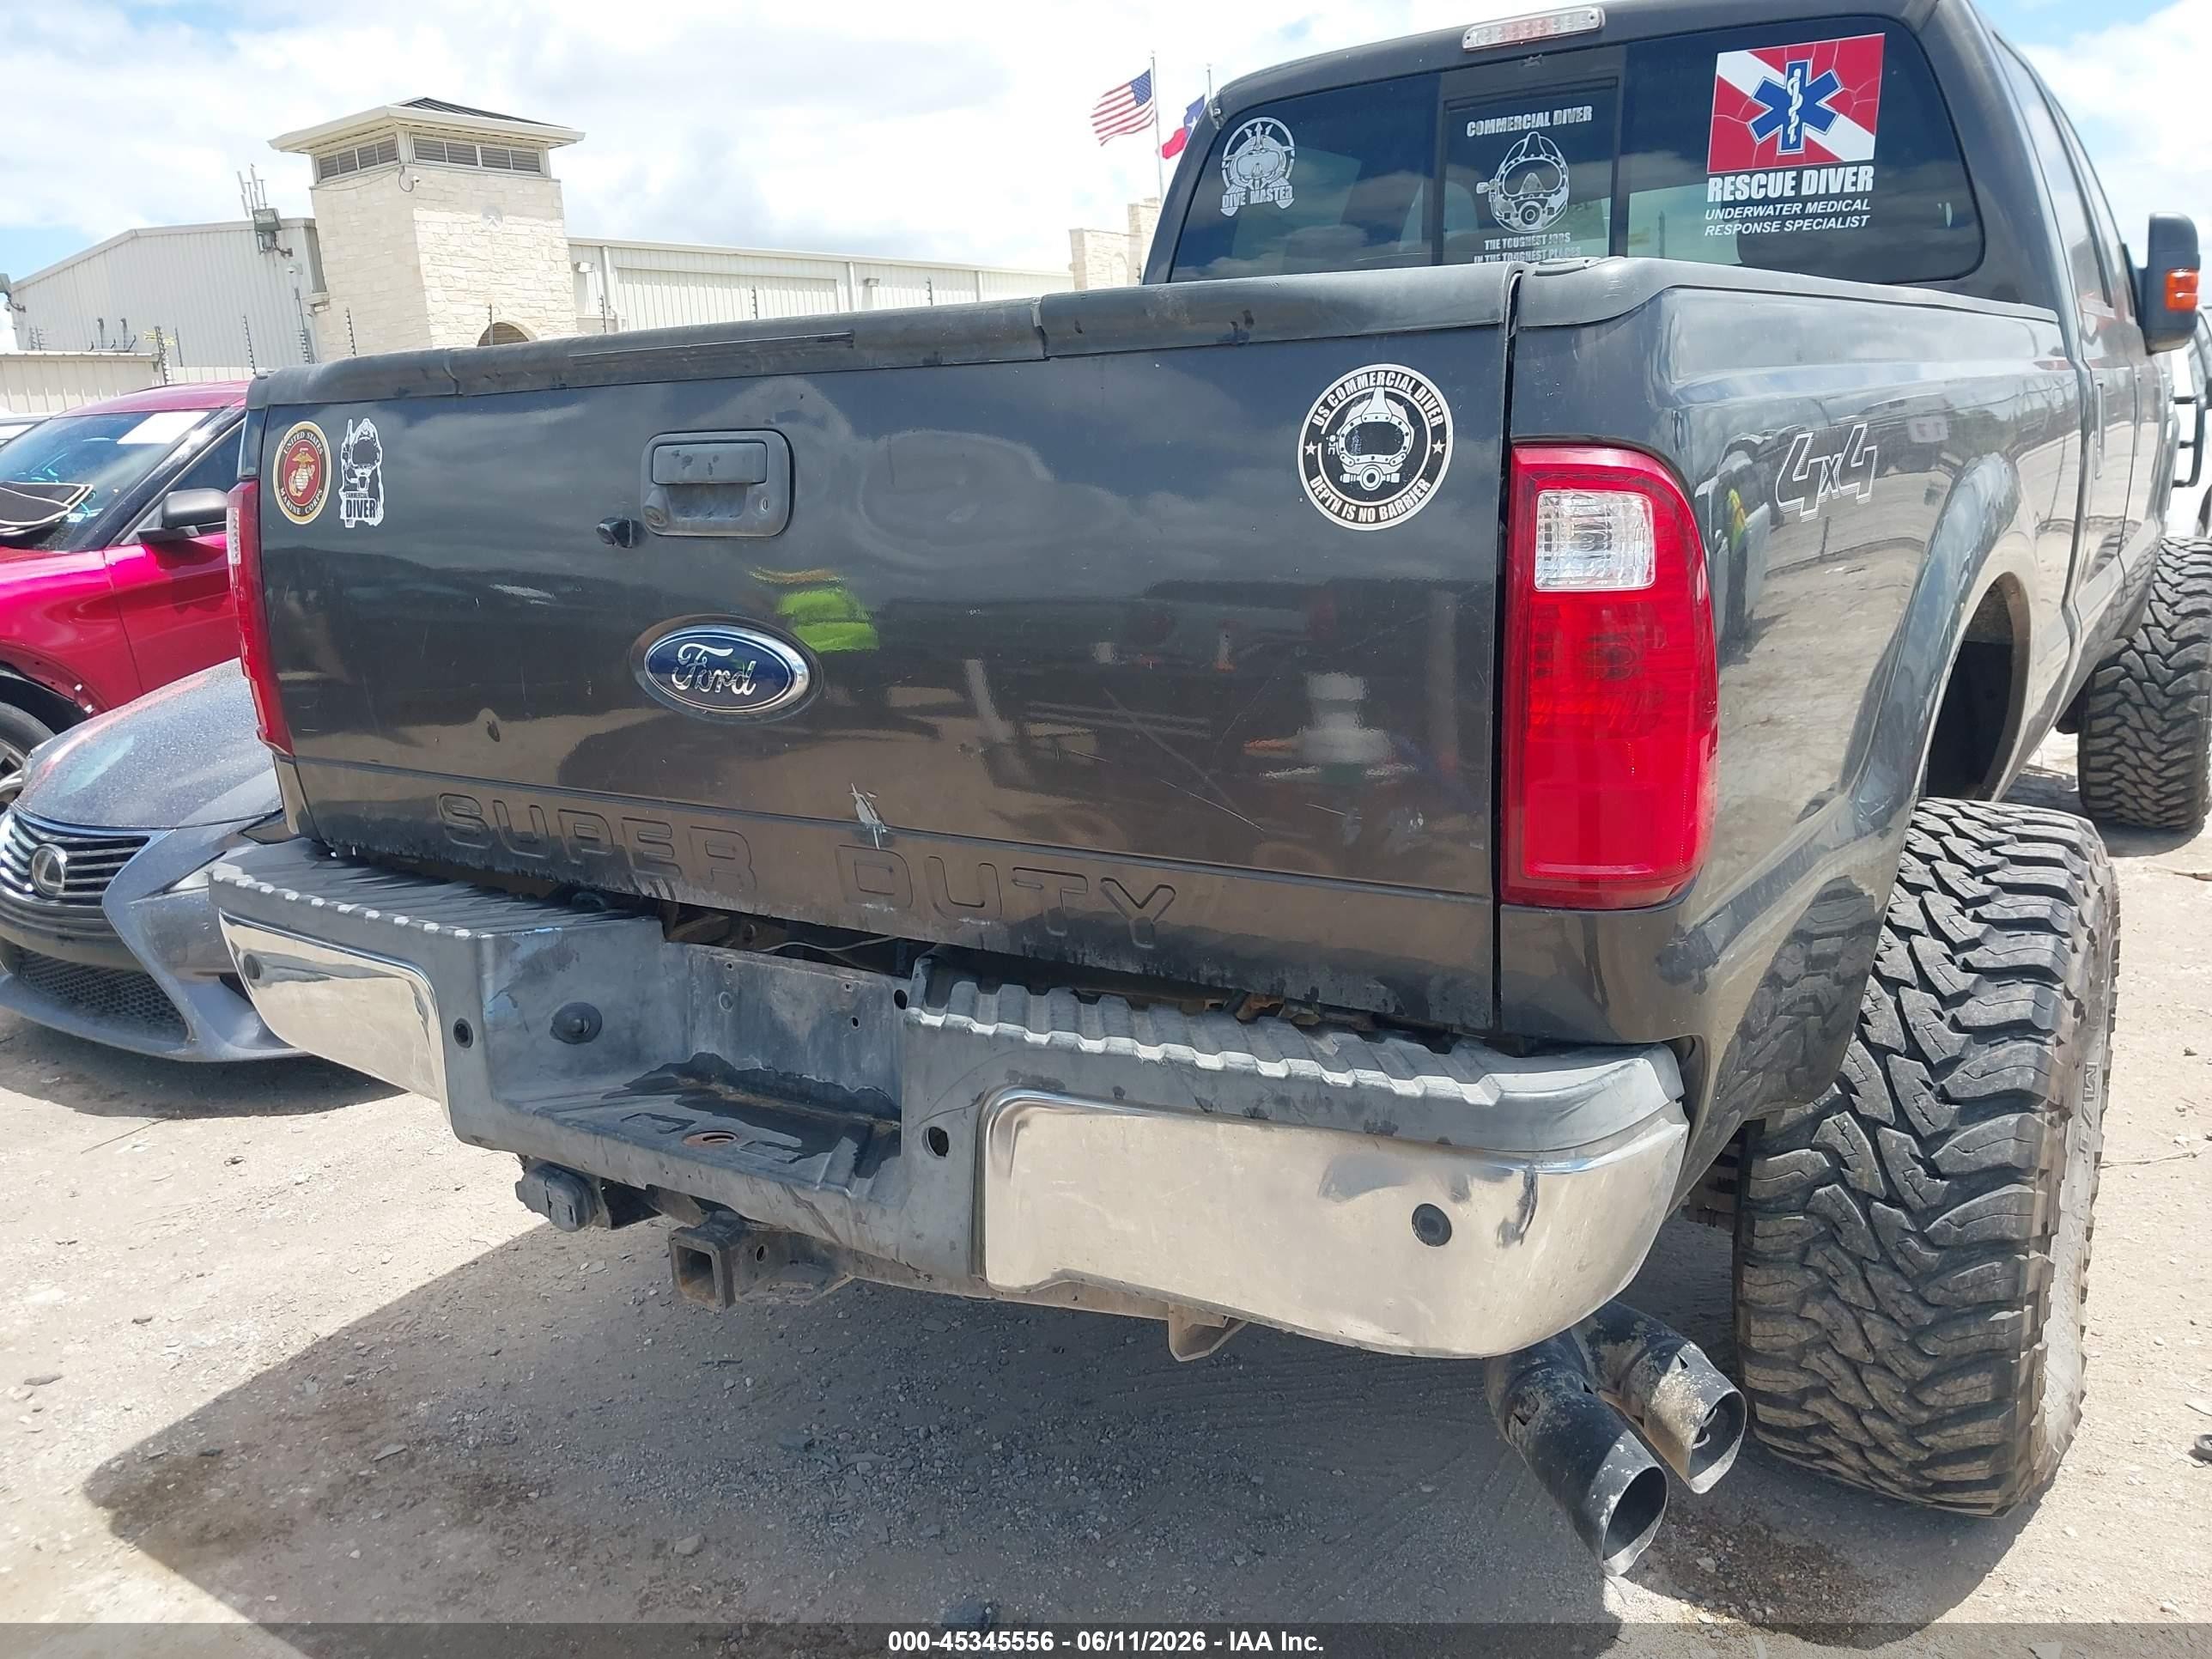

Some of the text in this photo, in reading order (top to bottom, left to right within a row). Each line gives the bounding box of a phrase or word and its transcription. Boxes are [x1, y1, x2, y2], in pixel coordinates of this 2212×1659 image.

[1467, 106, 1593, 137] COMMERCIAL DIVER
[1222, 185, 1293, 208] DIVE MASTER
[1706, 166, 1875, 203] RESCUE DIVER
[1705, 198, 1871, 220] UNDERWATER MEDICAL
[1705, 215, 1870, 236] RESPONSE SPECIALIST
[1484, 240, 1500, 251] THE
[1502, 234, 1547, 249] TOUGHEST
[1311, 371, 1445, 428] US COMMERCIAL DIVER
[283, 431, 324, 455] UNITED STATES
[1776, 423, 1879, 522] 4x4
[280, 487, 323, 515] MARINE CORPS
[345, 499, 376, 519] DIVER
[1310, 474, 1431, 522] DEPTH IS NO BARRIER
[672, 642, 757, 696] Ford
[438, 793, 1176, 949] SUPER DUTY
